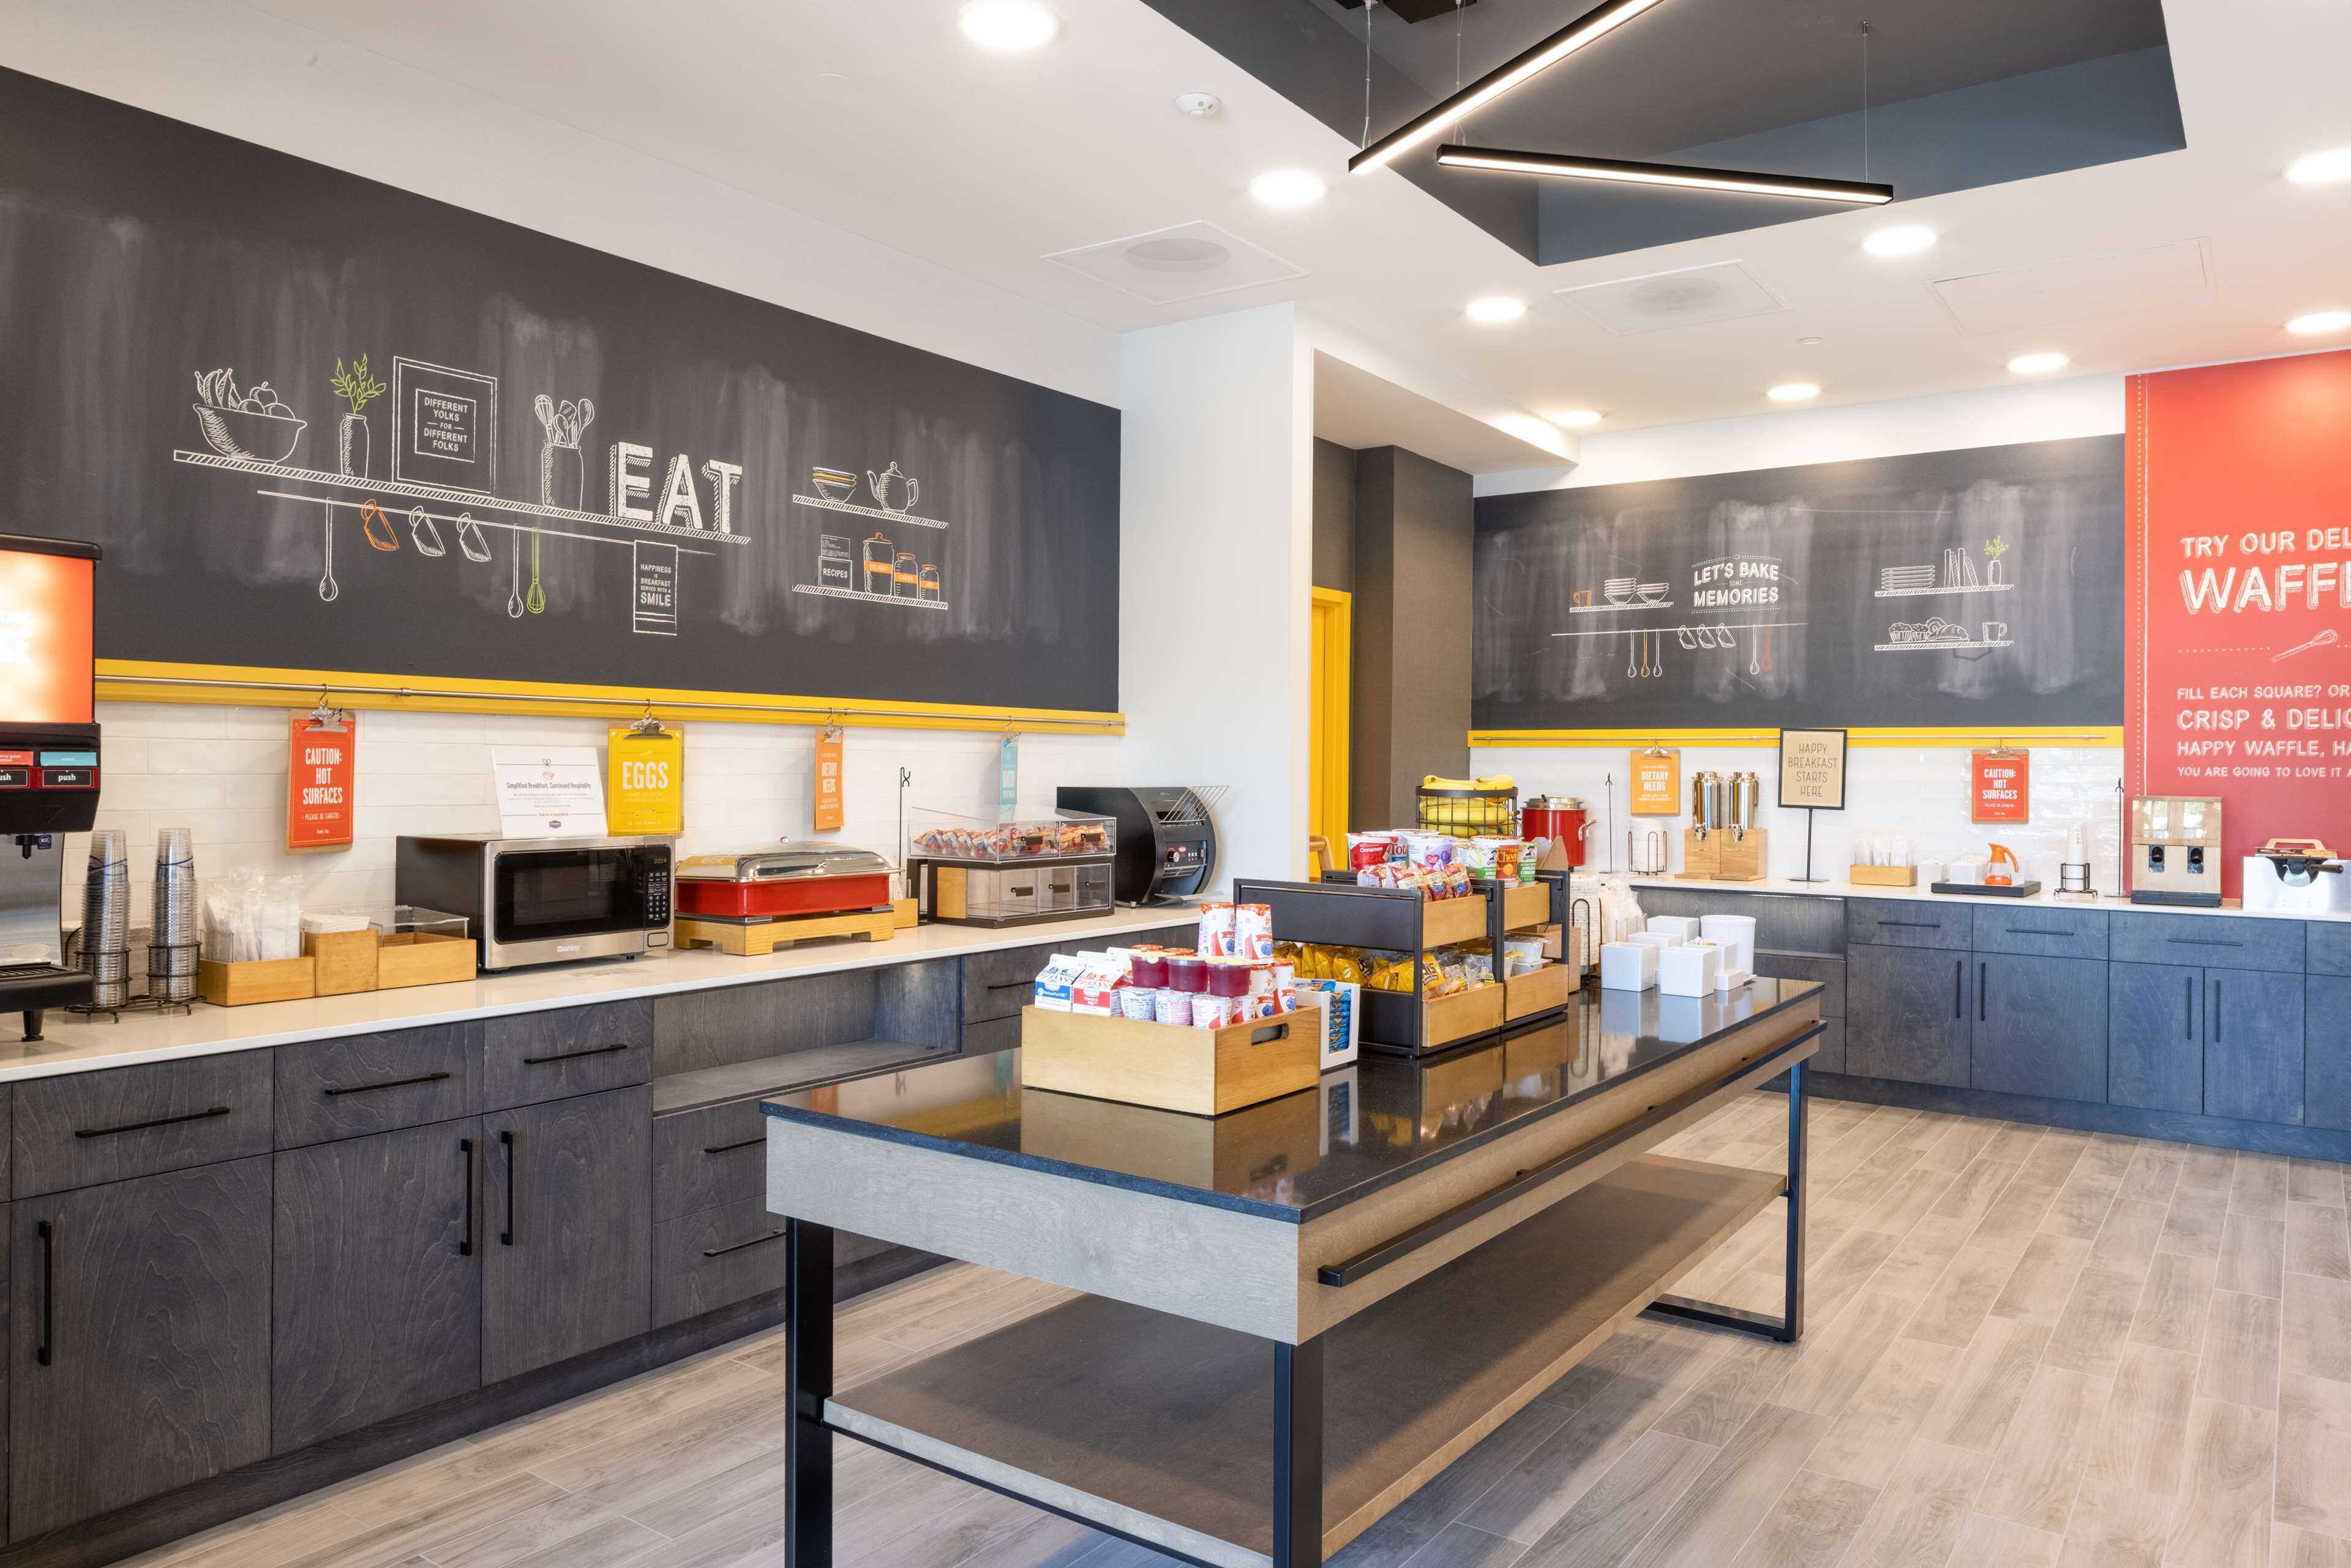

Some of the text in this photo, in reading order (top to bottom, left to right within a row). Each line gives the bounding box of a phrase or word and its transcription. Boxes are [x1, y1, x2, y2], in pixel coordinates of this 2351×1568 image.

[424, 397, 468, 413] DIFFERENT
[433, 409, 460, 422] YOLKS
[424, 427, 468, 443] DIFFERENT
[433, 440, 459, 452] FOLKS
[610, 441, 743, 534] EAT
[2180, 527, 2351, 558] TRY OUR DEL
[640, 563, 672, 574] HAPPINESS
[823, 568, 848, 579] RECIPES
[1693, 561, 1779, 587] LET'S BAKE
[640, 577, 672, 587] BREAKFAST
[640, 592, 672, 607] SMILE
[1693, 587, 1779, 607] MEMORIES
[2177, 684, 2350, 700] FILL EACH SQUARE? OR
[2177, 709, 2250, 730] CRISP
[2260, 708, 2276, 730] &
[1799, 743, 1828, 754] HAPPY
[2177, 740, 2237, 756] HAPPY
[2244, 740, 2325, 759] WAFFLE,
[305, 748, 342, 765] CAUTION:
[1788, 757, 1838, 768] BREAKFAST
[58, 773, 76, 782] push
[316, 768, 332, 784] HOT
[622, 761, 669, 789] EGGS
[1641, 771, 1669, 781] DIETARY
[1796, 771, 1828, 782] STARTS
[1984, 768, 2017, 778] CAUTION:
[2178, 767, 2200, 778] YOU
[2205, 767, 2229, 777] ARE
[2233, 767, 2271, 777] GOING
[2274, 767, 2292, 777] TO
[2295, 767, 2327, 777] LOVE
[2331, 767, 2342, 778] IT
[506, 782, 528, 790] Simplified
[1643, 781, 1666, 791] NEEDS
[1993, 779, 2008, 789] HOT
[303, 787, 343, 805] SURFACES
[1800, 786, 1823, 797] HERE
[1982, 789, 2018, 800] SURFACES
